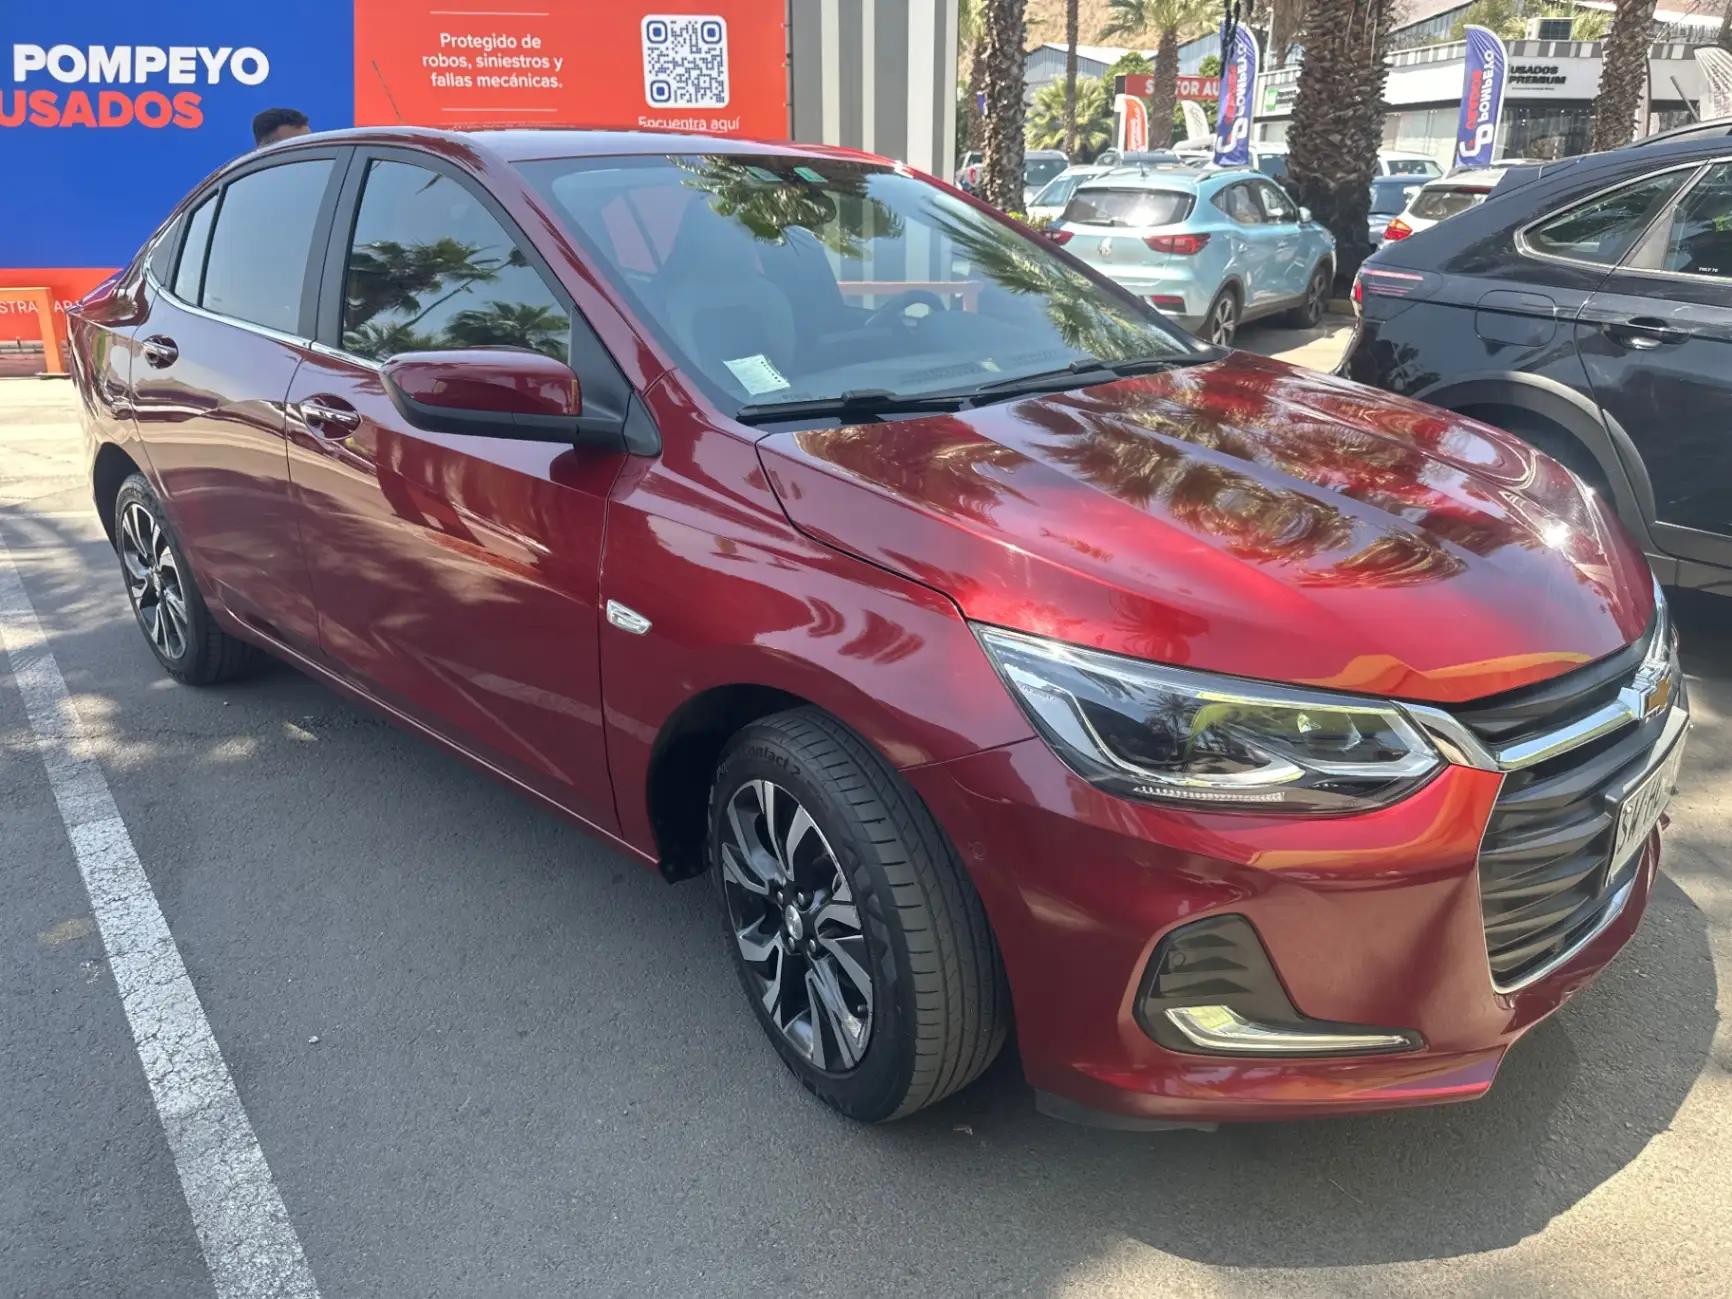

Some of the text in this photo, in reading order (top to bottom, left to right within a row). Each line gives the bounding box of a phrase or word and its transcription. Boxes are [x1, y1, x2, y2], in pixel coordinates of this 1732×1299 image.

[440, 32, 542, 51] Protegido de
[13, 43, 270, 86] POMPEYO
[422, 53, 563, 72] robos, siniestros y
[1510, 66, 1559, 75] USADOS
[430, 72, 564, 88] fallas mecánicas.
[1508, 76, 1567, 84] PREMIUM
[0, 89, 204, 129] USADOS
[711, 115, 741, 133] aquí
